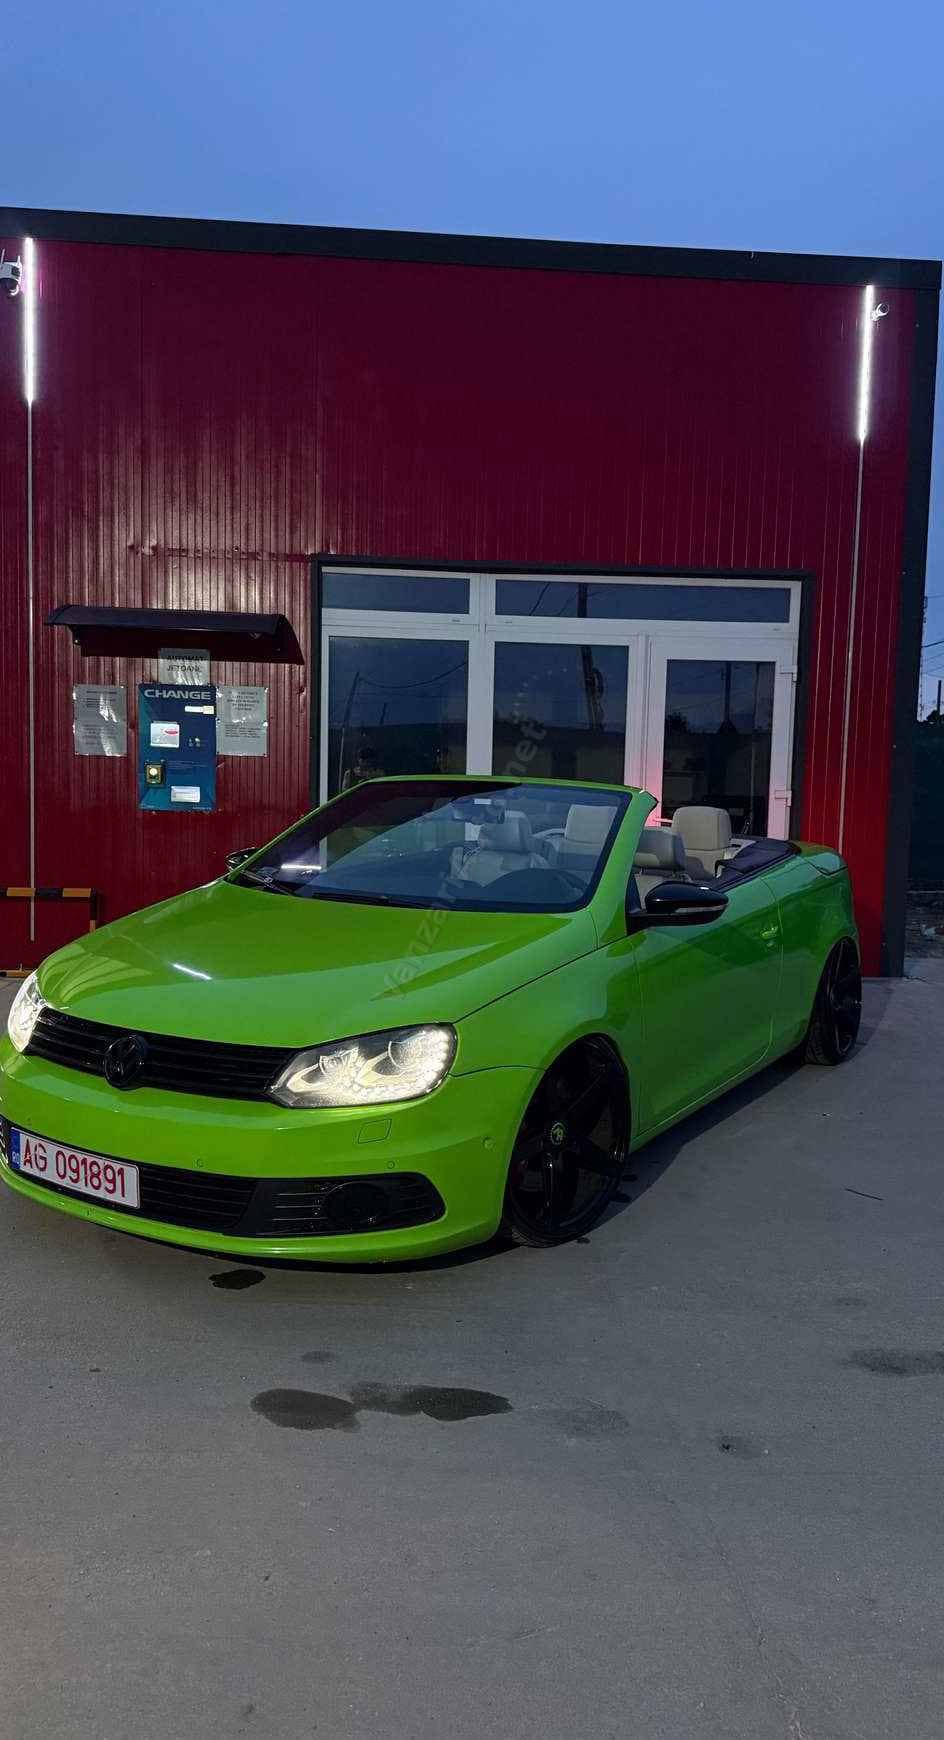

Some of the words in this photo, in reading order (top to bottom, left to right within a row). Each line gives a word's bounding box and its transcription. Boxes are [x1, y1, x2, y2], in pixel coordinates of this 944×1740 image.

[144, 689, 211, 700] CHANGE
[23, 1138, 48, 1172] AG
[55, 1150, 126, 1198] 091891
